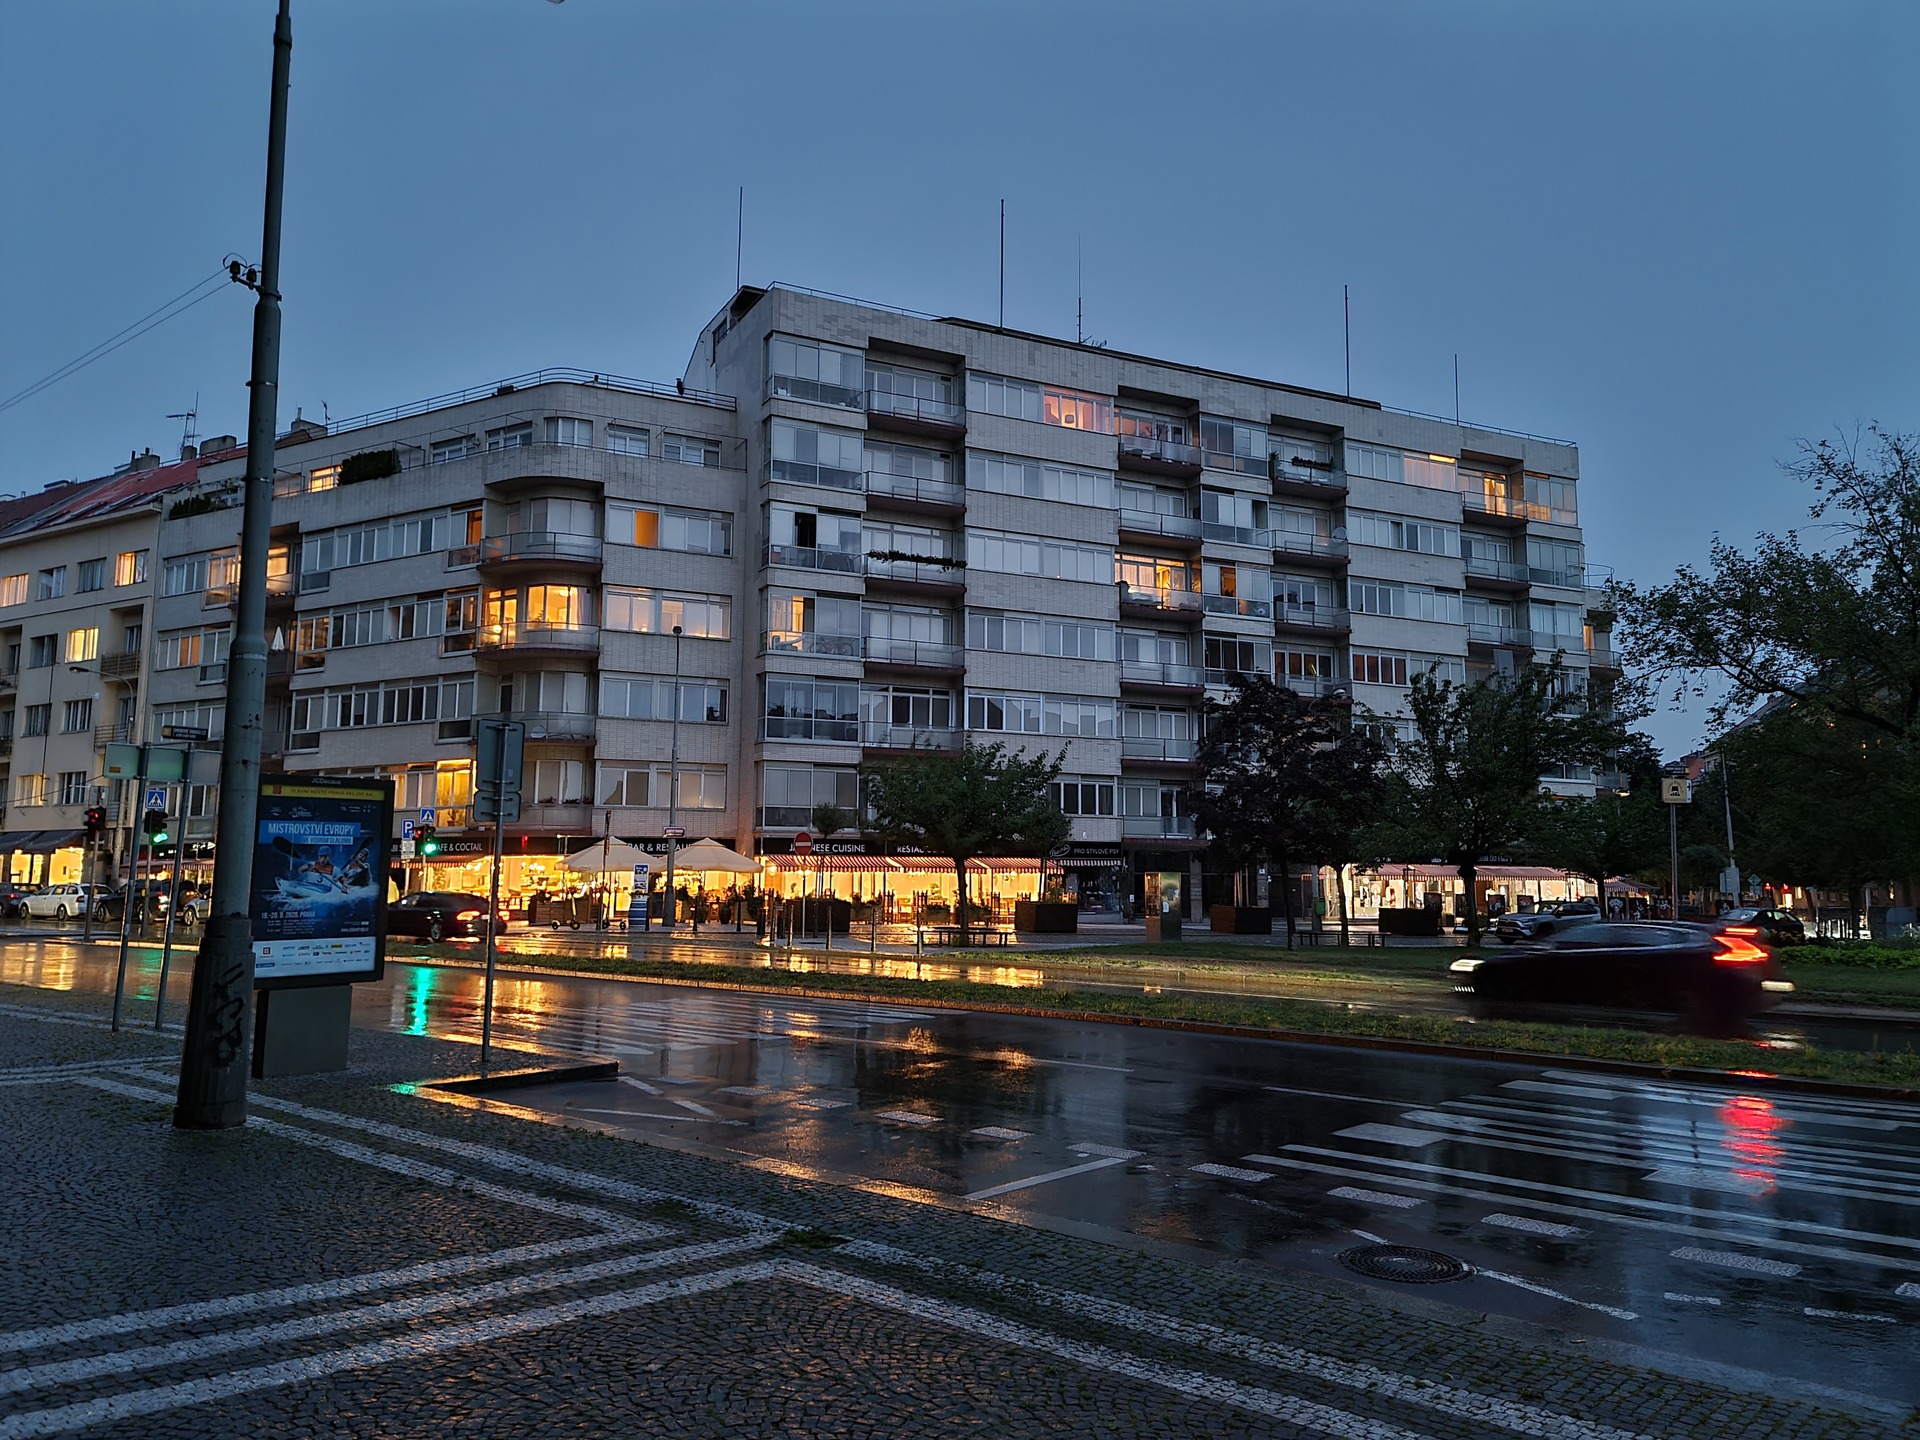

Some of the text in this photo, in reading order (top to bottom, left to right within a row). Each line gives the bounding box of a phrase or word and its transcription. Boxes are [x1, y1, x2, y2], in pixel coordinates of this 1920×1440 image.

[267, 821, 355, 836] MISTROVSTVÍ EVROPY
[404, 821, 413, 834] P
[455, 842, 483, 852] COCTAIL
[646, 843, 654, 852] &
[831, 844, 866, 853] CUISINE
